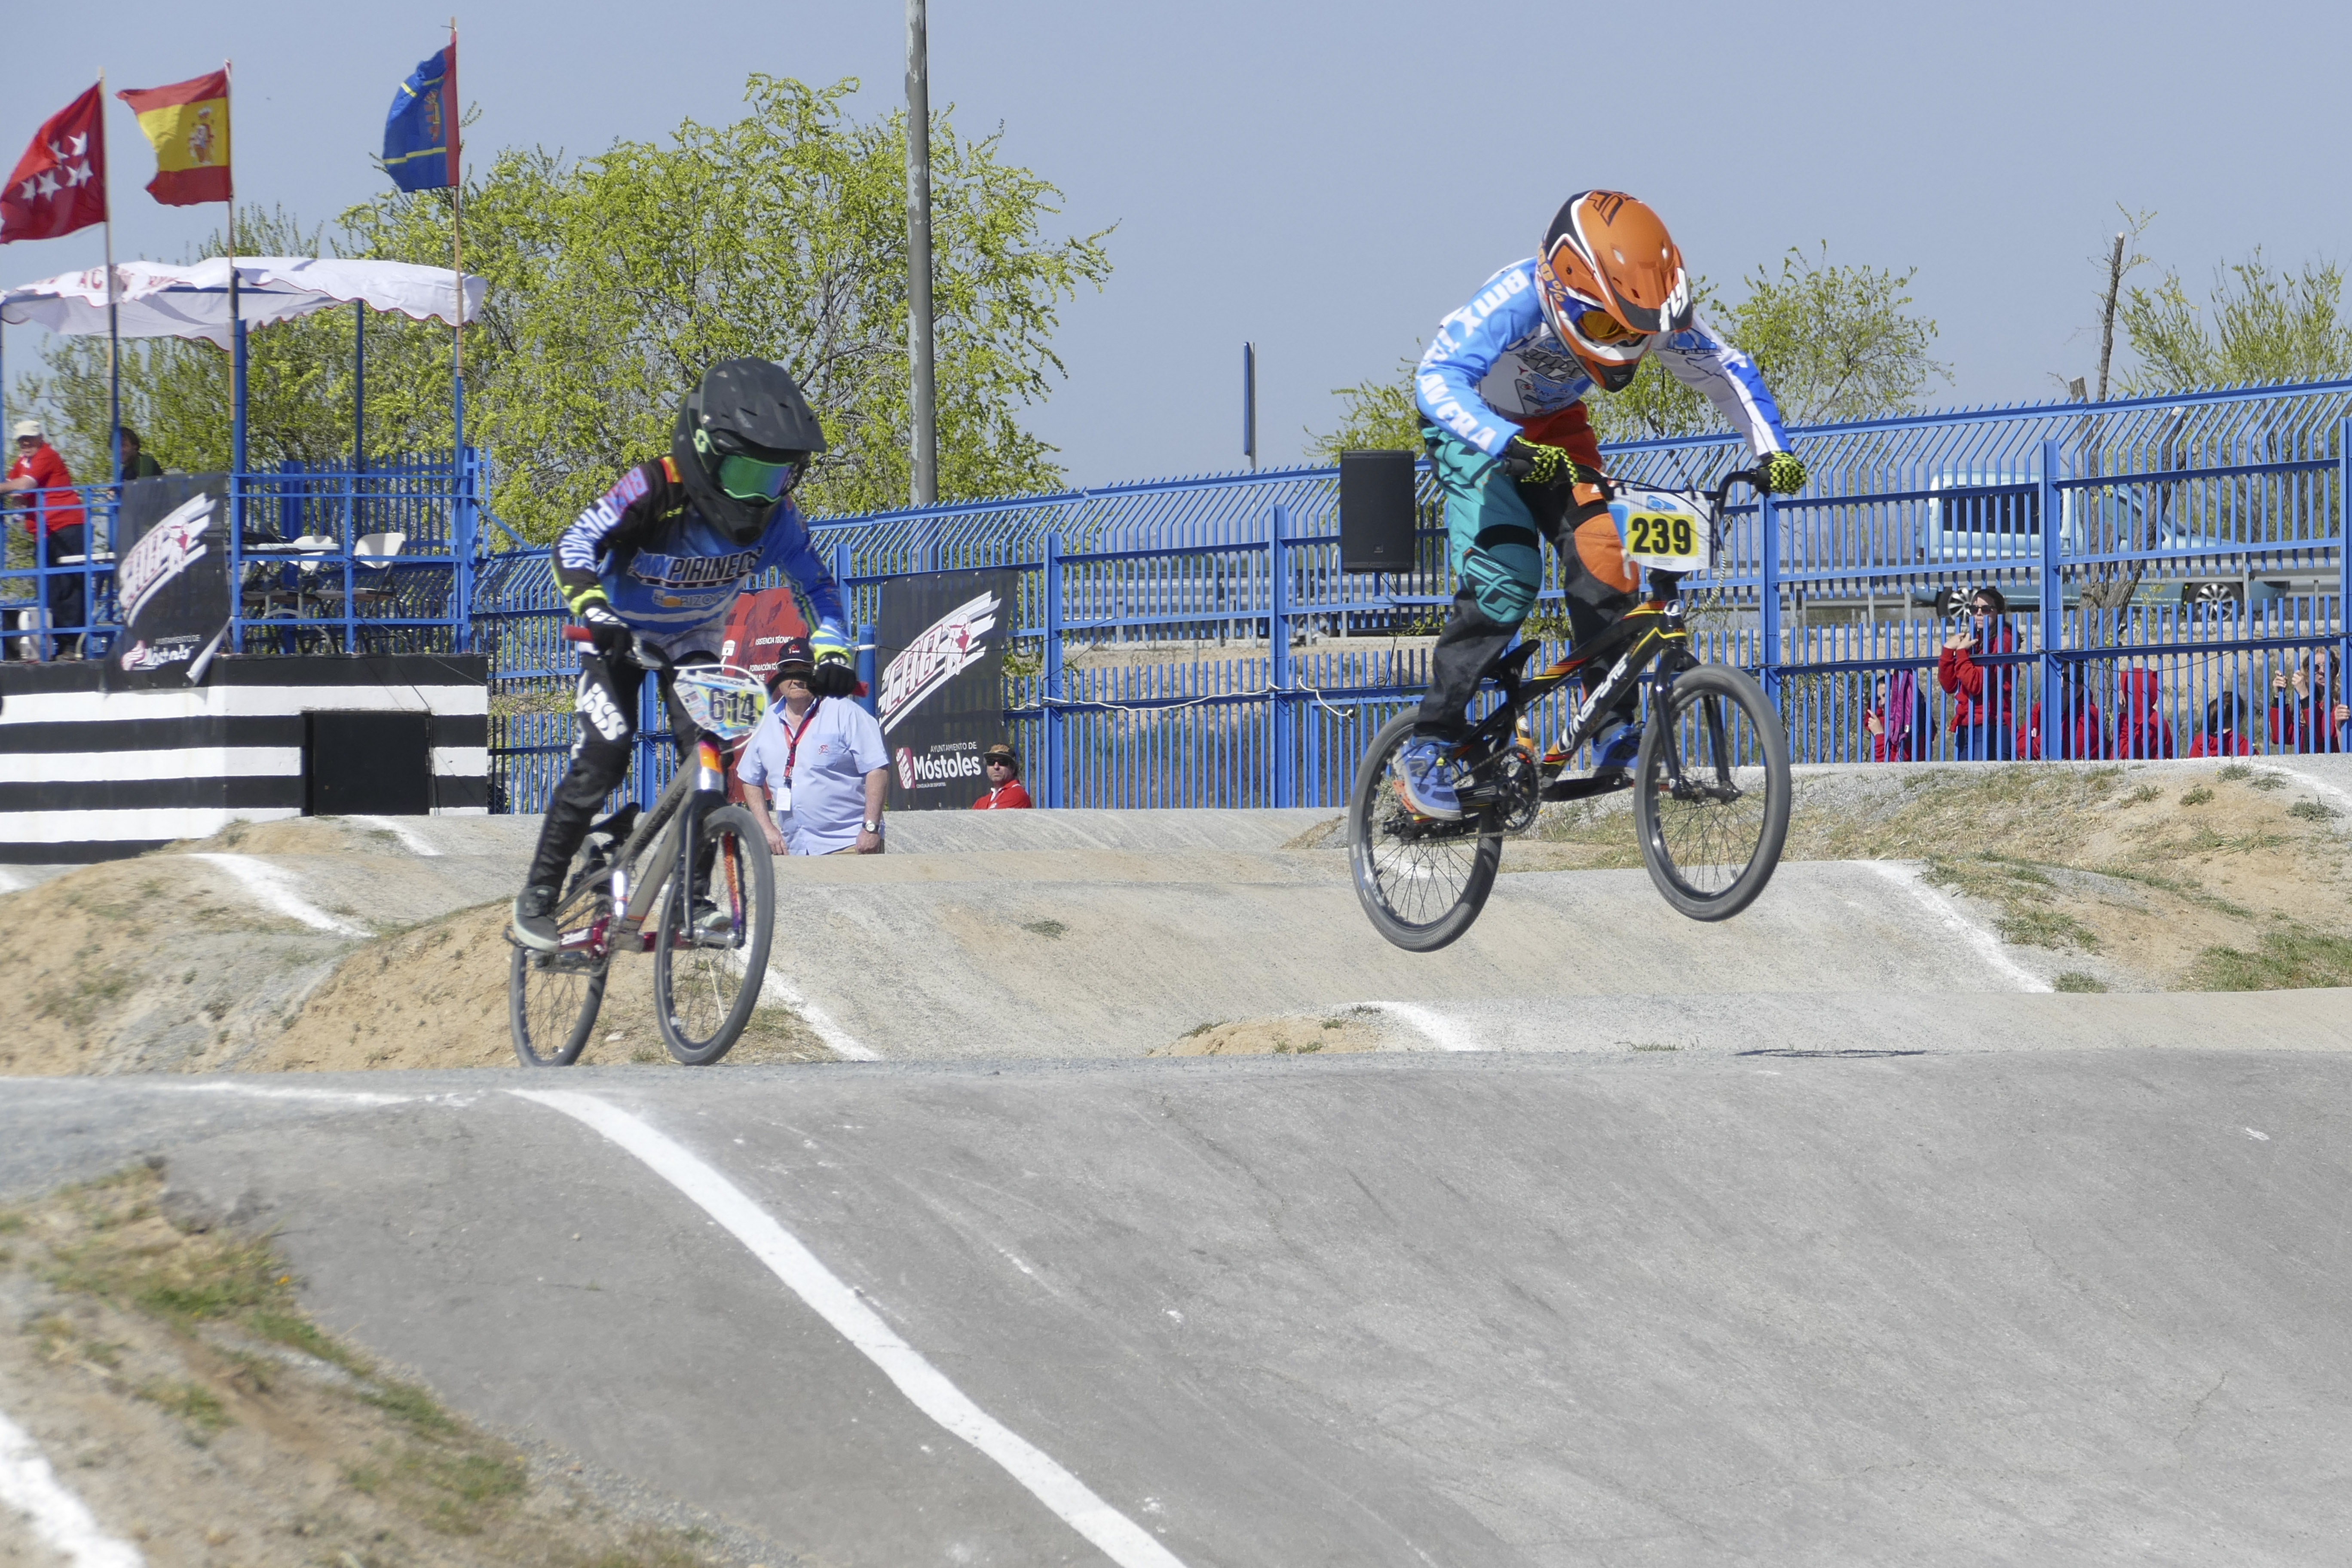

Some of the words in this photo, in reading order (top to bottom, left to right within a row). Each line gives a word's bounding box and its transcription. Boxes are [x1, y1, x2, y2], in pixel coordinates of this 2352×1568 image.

[1537, 242, 1568, 302] 00%
[1454, 268, 1530, 338] BMX
[1416, 328, 1497, 451] TAAVERA
[1631, 518, 1691, 555] 239
[709, 688, 757, 729] 614
[913, 752, 982, 780] Móstoles
[930, 742, 967, 753] AYUNTAMIENTO
[968, 741, 977, 750] DE
